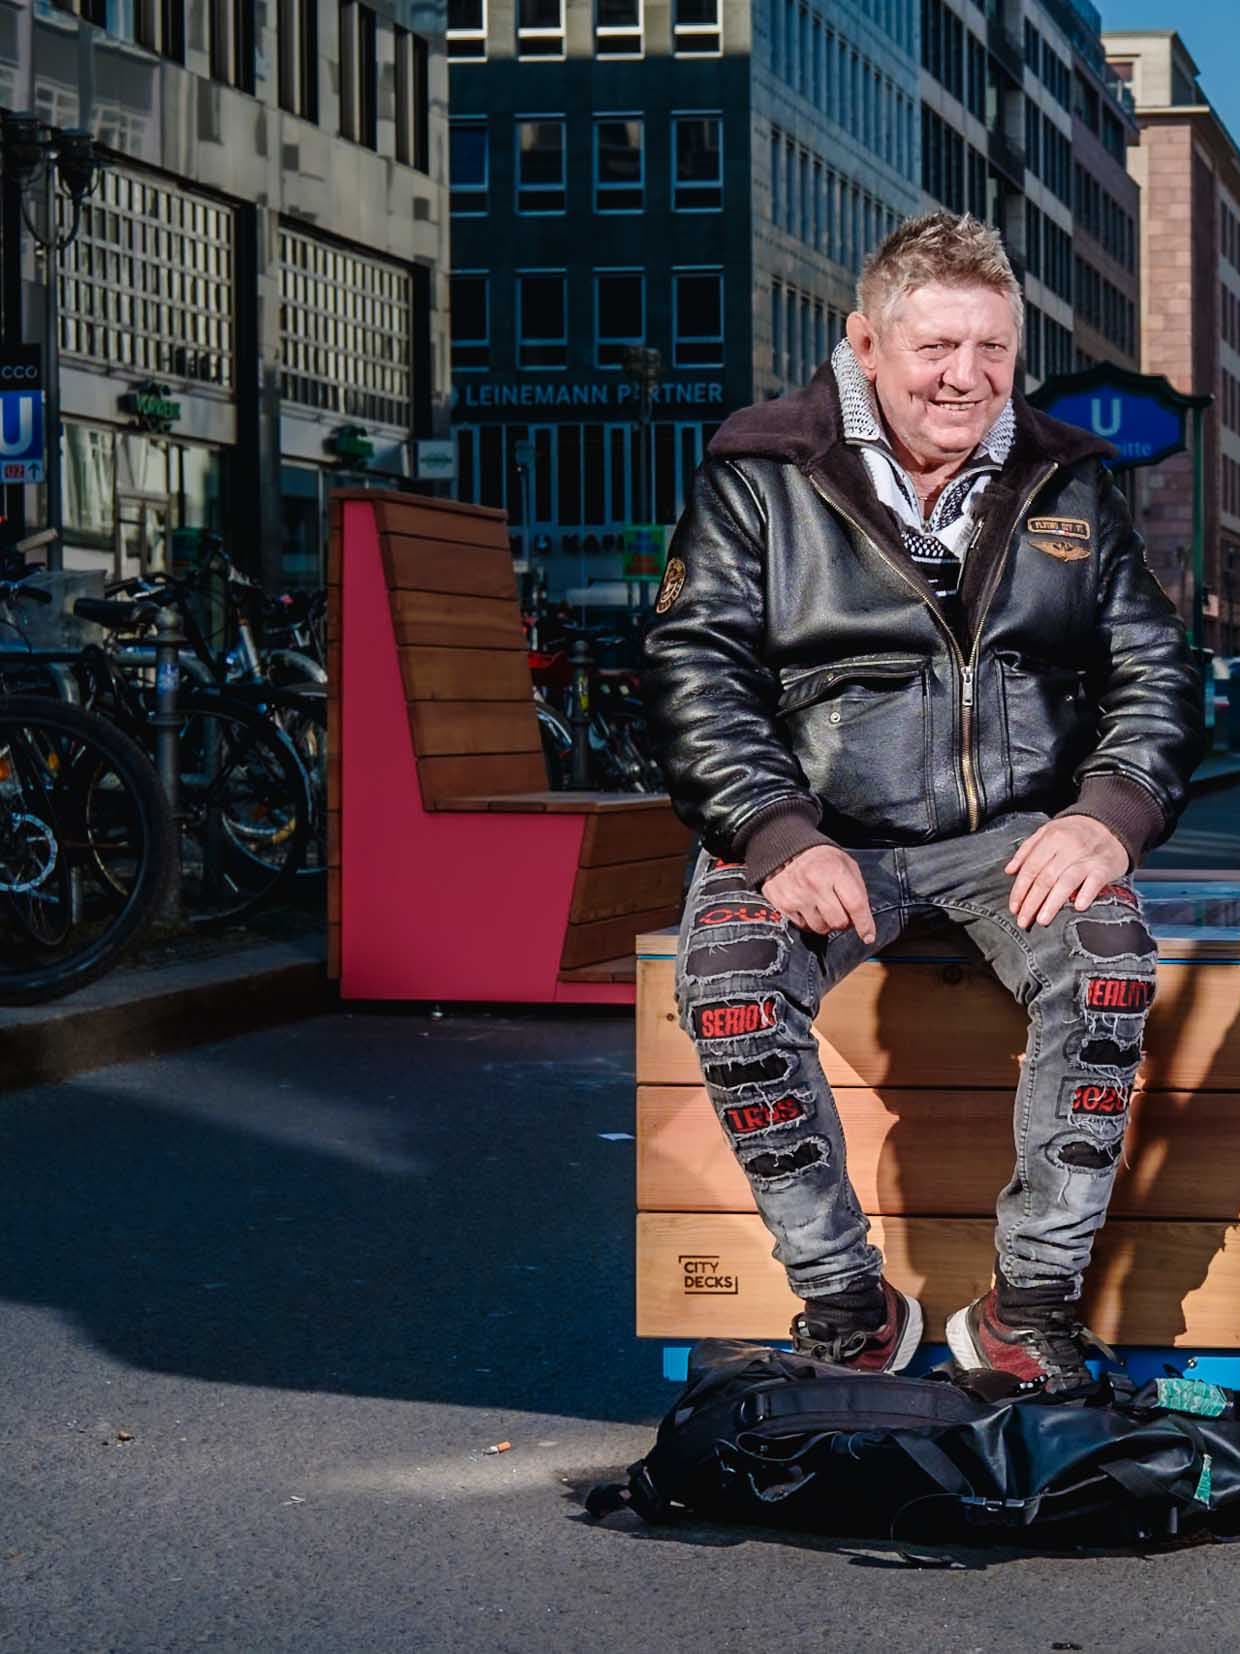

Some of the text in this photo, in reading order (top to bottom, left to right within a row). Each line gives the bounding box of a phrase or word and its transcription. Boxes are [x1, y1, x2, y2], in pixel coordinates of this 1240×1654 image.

[465, 383, 608, 408] LEINEMANN
[1090, 397, 1121, 437] U
[684, 1261, 719, 1273] CITY
[684, 1275, 733, 1288] DECKS
